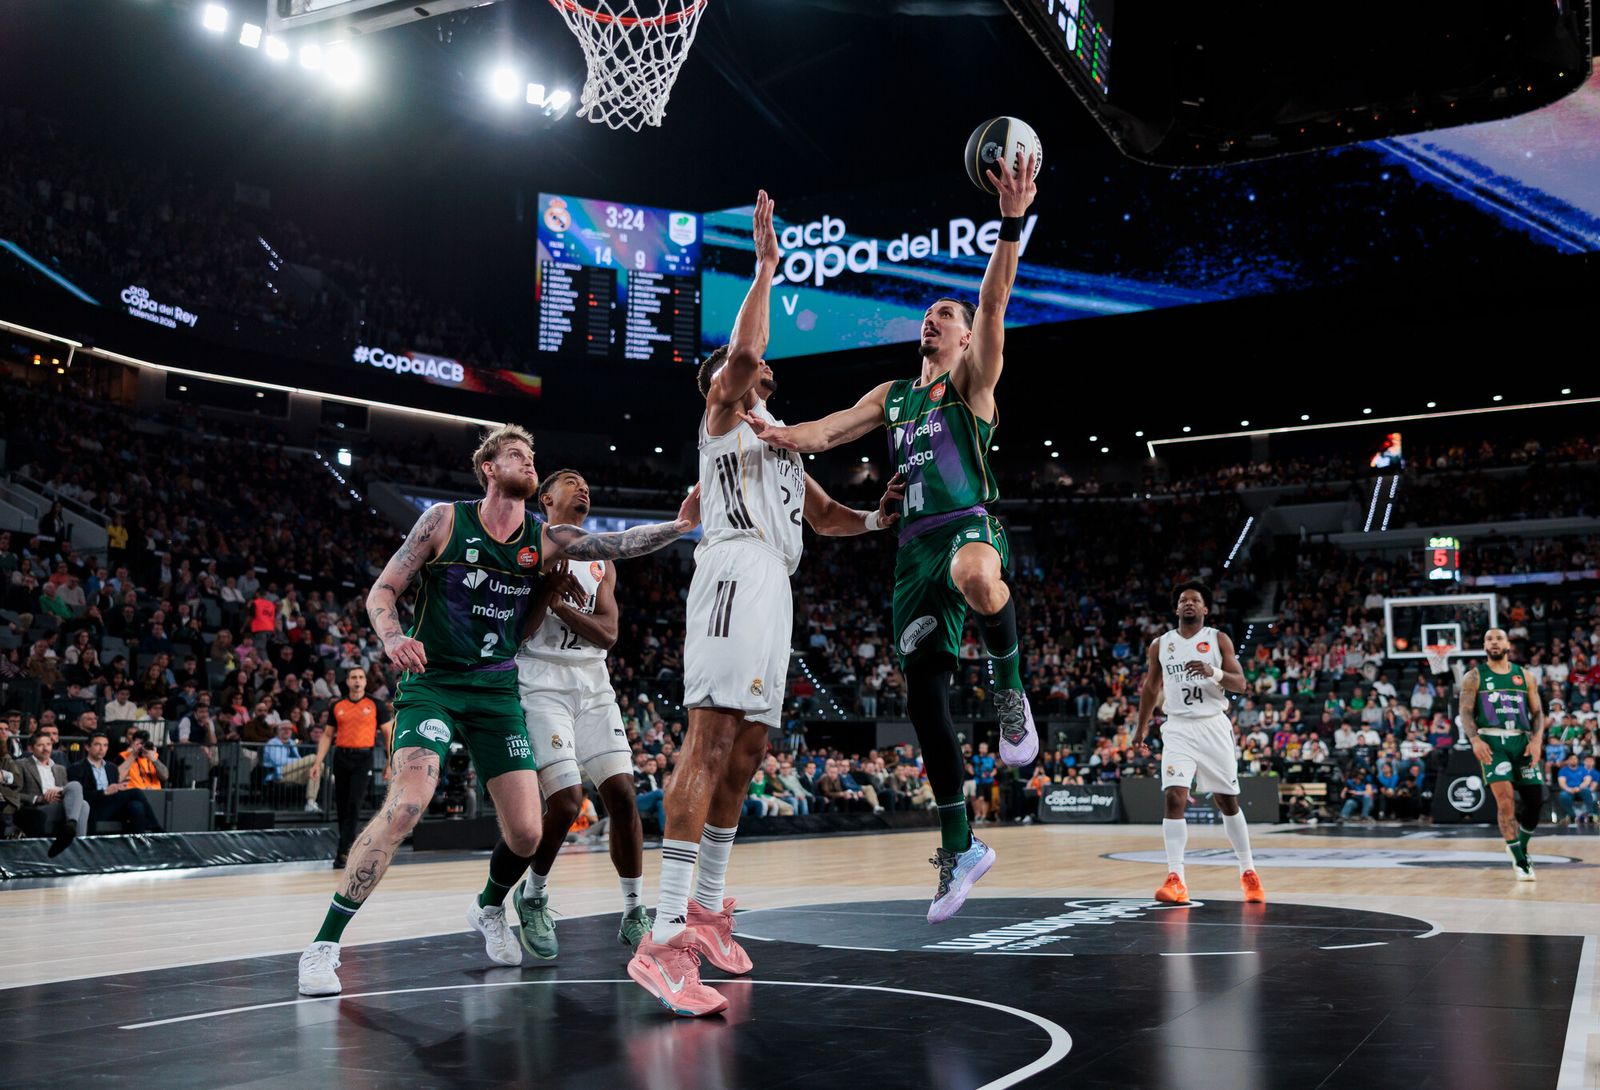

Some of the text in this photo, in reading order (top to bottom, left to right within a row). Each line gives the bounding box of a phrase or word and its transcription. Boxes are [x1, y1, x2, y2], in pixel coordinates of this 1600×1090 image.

[606, 206, 645, 231] 3:24
[781, 215, 846, 249] acb
[886, 228, 938, 262] del
[595, 246, 612, 266] 14
[635, 250, 646, 270] 9
[129, 285, 150, 300] acb
[121, 288, 158, 313] Copa
[174, 306, 198, 327] Rey
[353, 346, 464, 382] #CopaACB
[1434, 549, 1449, 567] 5
[480, 633, 499, 657] 2
[1182, 686, 1204, 705] 24
[508, 746, 531, 758] laga
[1045, 795, 1077, 806] Copa
[1091, 795, 1113, 807] Rey
